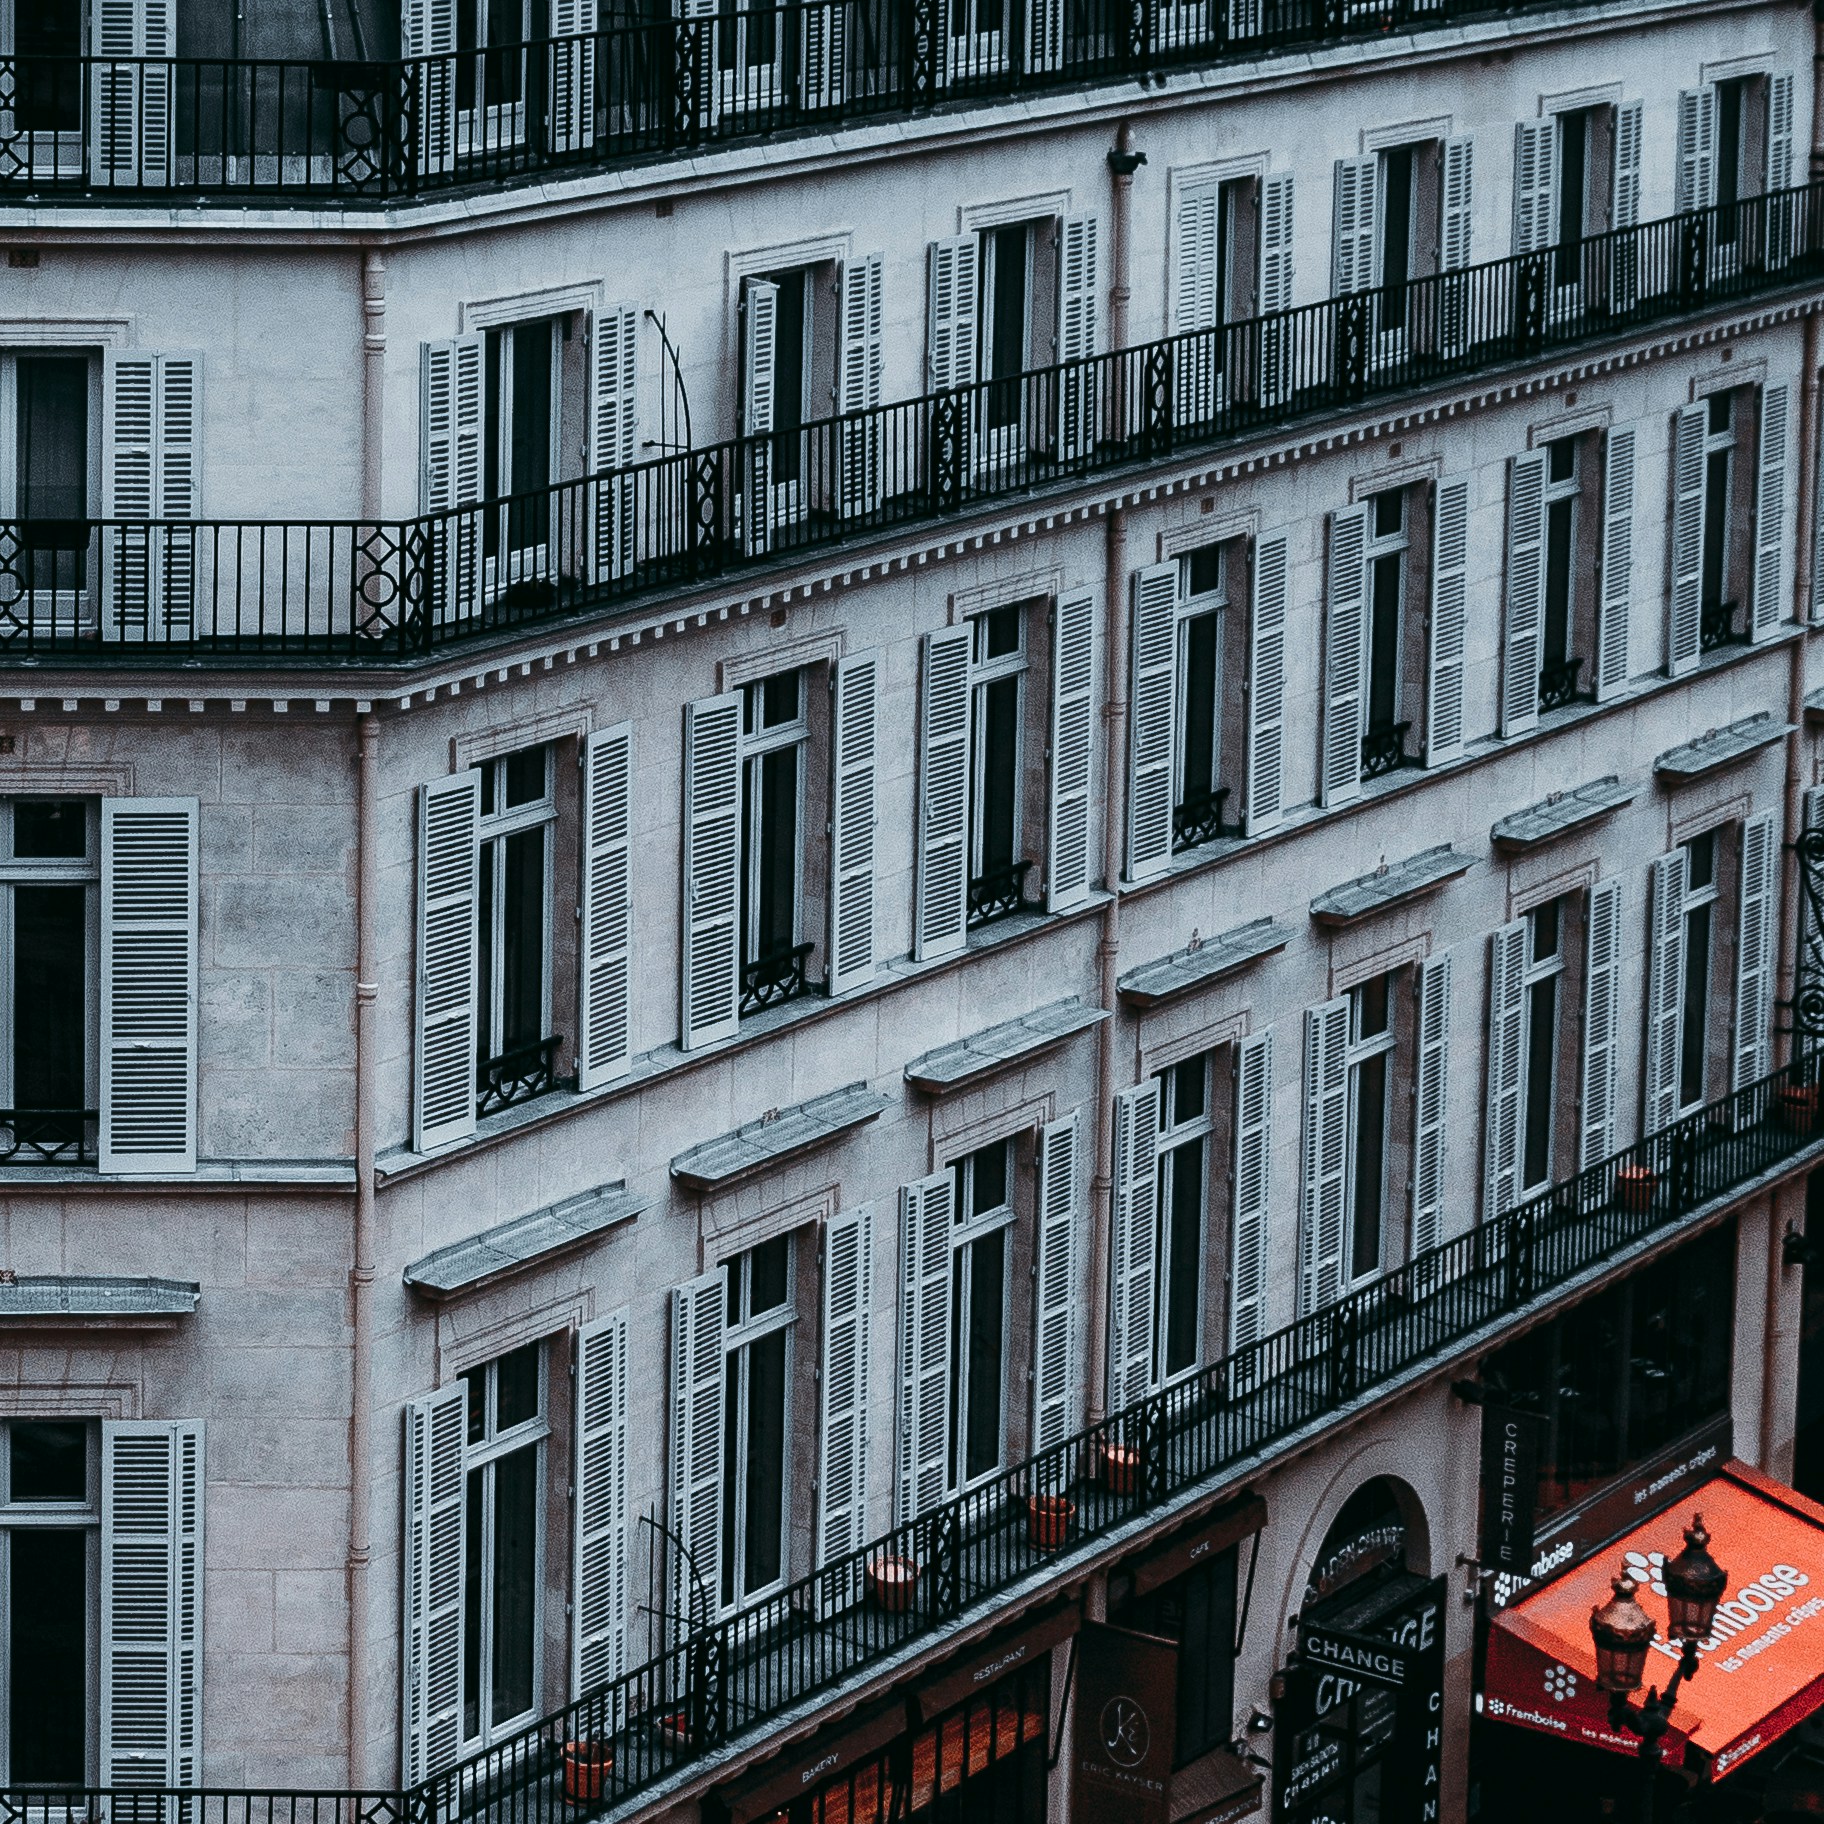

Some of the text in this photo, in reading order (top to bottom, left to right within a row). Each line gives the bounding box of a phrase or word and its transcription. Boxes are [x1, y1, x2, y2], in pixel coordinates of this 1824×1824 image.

[1306, 1636, 1406, 1678] CHANGE
[802, 1752, 839, 1783] BAKERY
[1082, 1761, 1164, 1792] ERIC KAYSER
